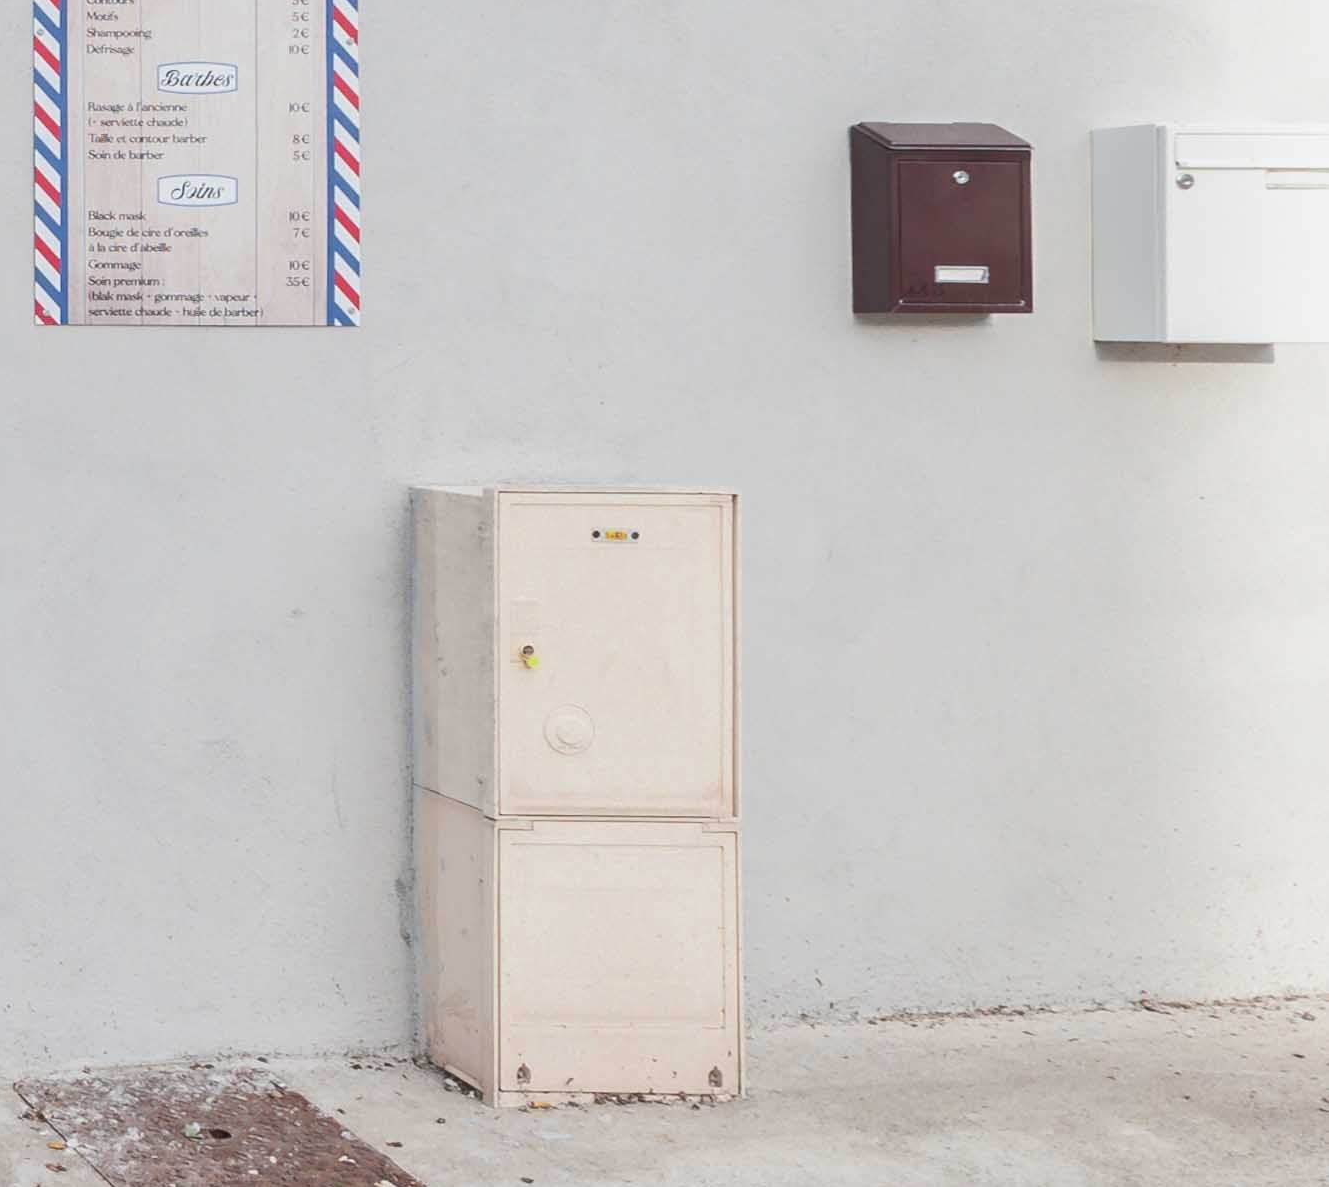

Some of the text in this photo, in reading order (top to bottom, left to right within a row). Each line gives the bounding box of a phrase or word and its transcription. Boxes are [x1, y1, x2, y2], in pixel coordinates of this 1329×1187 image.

[86, 27, 153, 40] Shampooing
[160, 69, 235, 88] Barbes
[87, 102, 124, 114] Rasage
[100, 117, 144, 127] serviette
[88, 133, 114, 143] Taille
[116, 134, 127, 143] et
[129, 134, 170, 143] contour
[172, 133, 208, 143] barber
[87, 150, 111, 160] Soin
[113, 150, 127, 159] de
[129, 150, 165, 160] barber
[170, 180, 226, 201] Soins
[87, 211, 116, 221] Black
[118, 211, 146, 221] mask
[87, 227, 124, 239] Bougie
[126, 227, 139, 237] de
[141, 228, 161, 237] cire
[108, 244, 127, 252] cire
[87, 259, 142, 271] Gommage
[88, 276, 111, 286] Soin
[113, 276, 160, 288] premium
[116, 291, 143, 301] mask
[154, 294, 204, 303] gommage
[214, 294, 250, 303] vapeur
[88, 307, 132, 317] serviette
[134, 307, 172, 317] chaude
[209, 307, 222, 317] de
